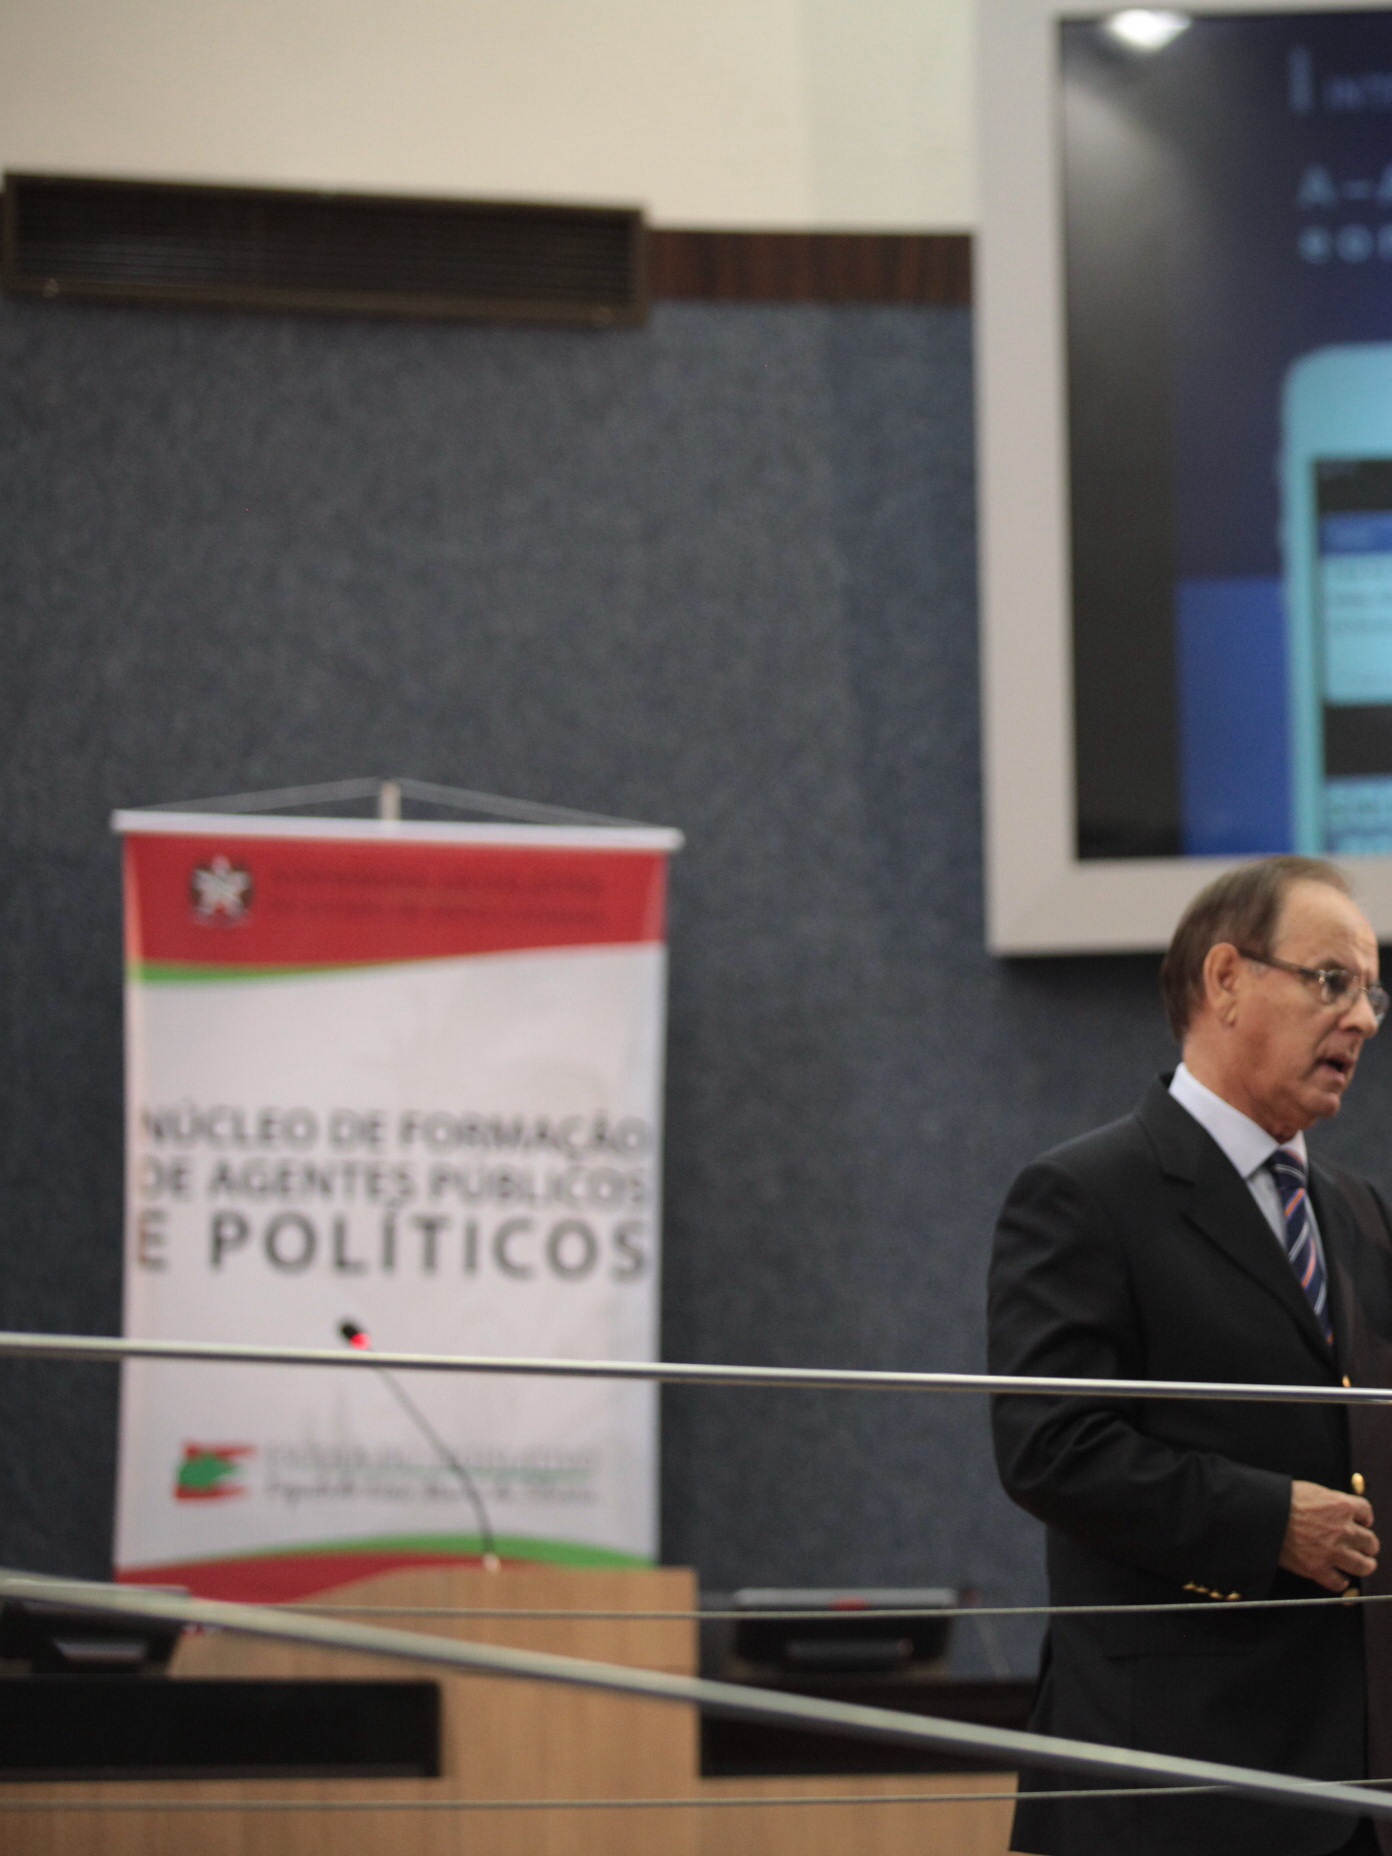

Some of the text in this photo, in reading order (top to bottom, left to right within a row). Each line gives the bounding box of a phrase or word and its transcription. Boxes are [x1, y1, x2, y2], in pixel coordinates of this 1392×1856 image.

[1297, 161, 1338, 208] A
[1298, 223, 1332, 264] e
[1336, 223, 1374, 264] o
[141, 1100, 652, 1163] NÚCLEO DE FORMAÇÃO
[138, 1155, 647, 1205] DE AGENTES PÚBLICOS
[136, 1199, 648, 1283] E POLÍTICOS
